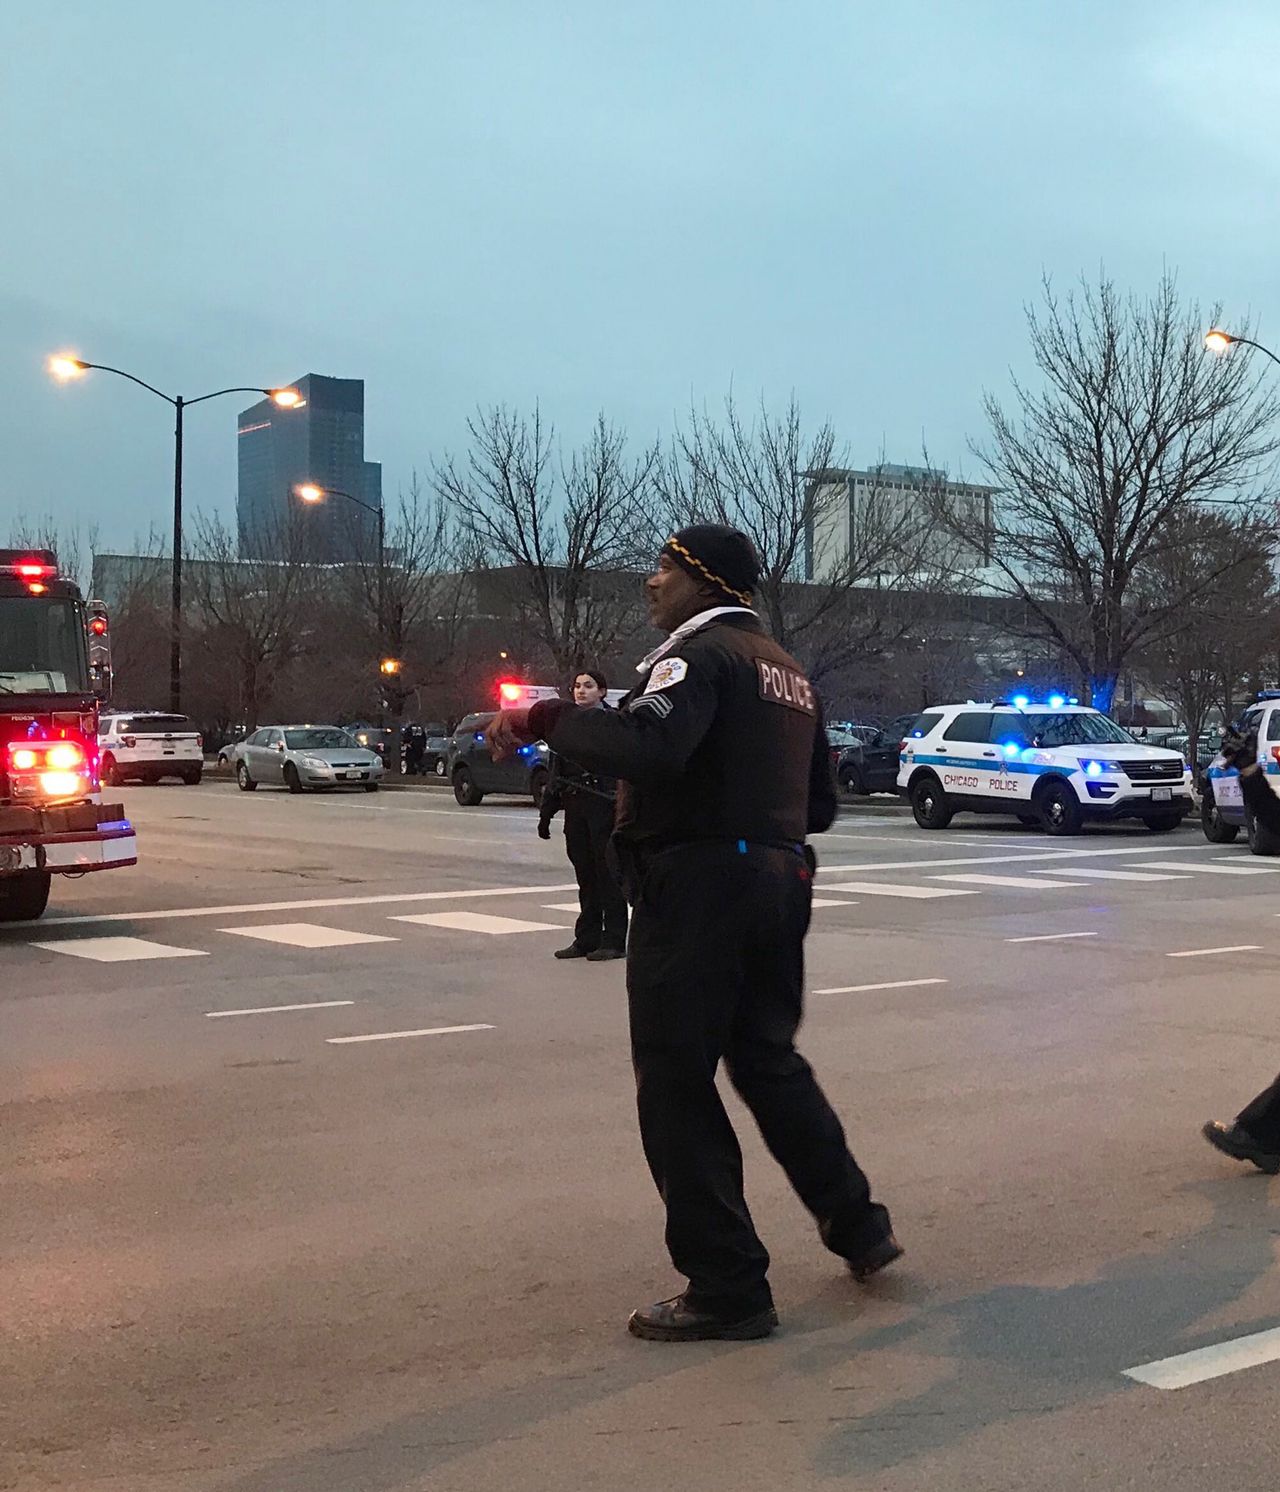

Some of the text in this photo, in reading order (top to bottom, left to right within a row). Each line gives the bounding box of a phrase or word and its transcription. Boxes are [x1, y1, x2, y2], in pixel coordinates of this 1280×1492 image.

[760, 662, 814, 710] POLICE
[944, 774, 1018, 792] CHICAGO POLICE
